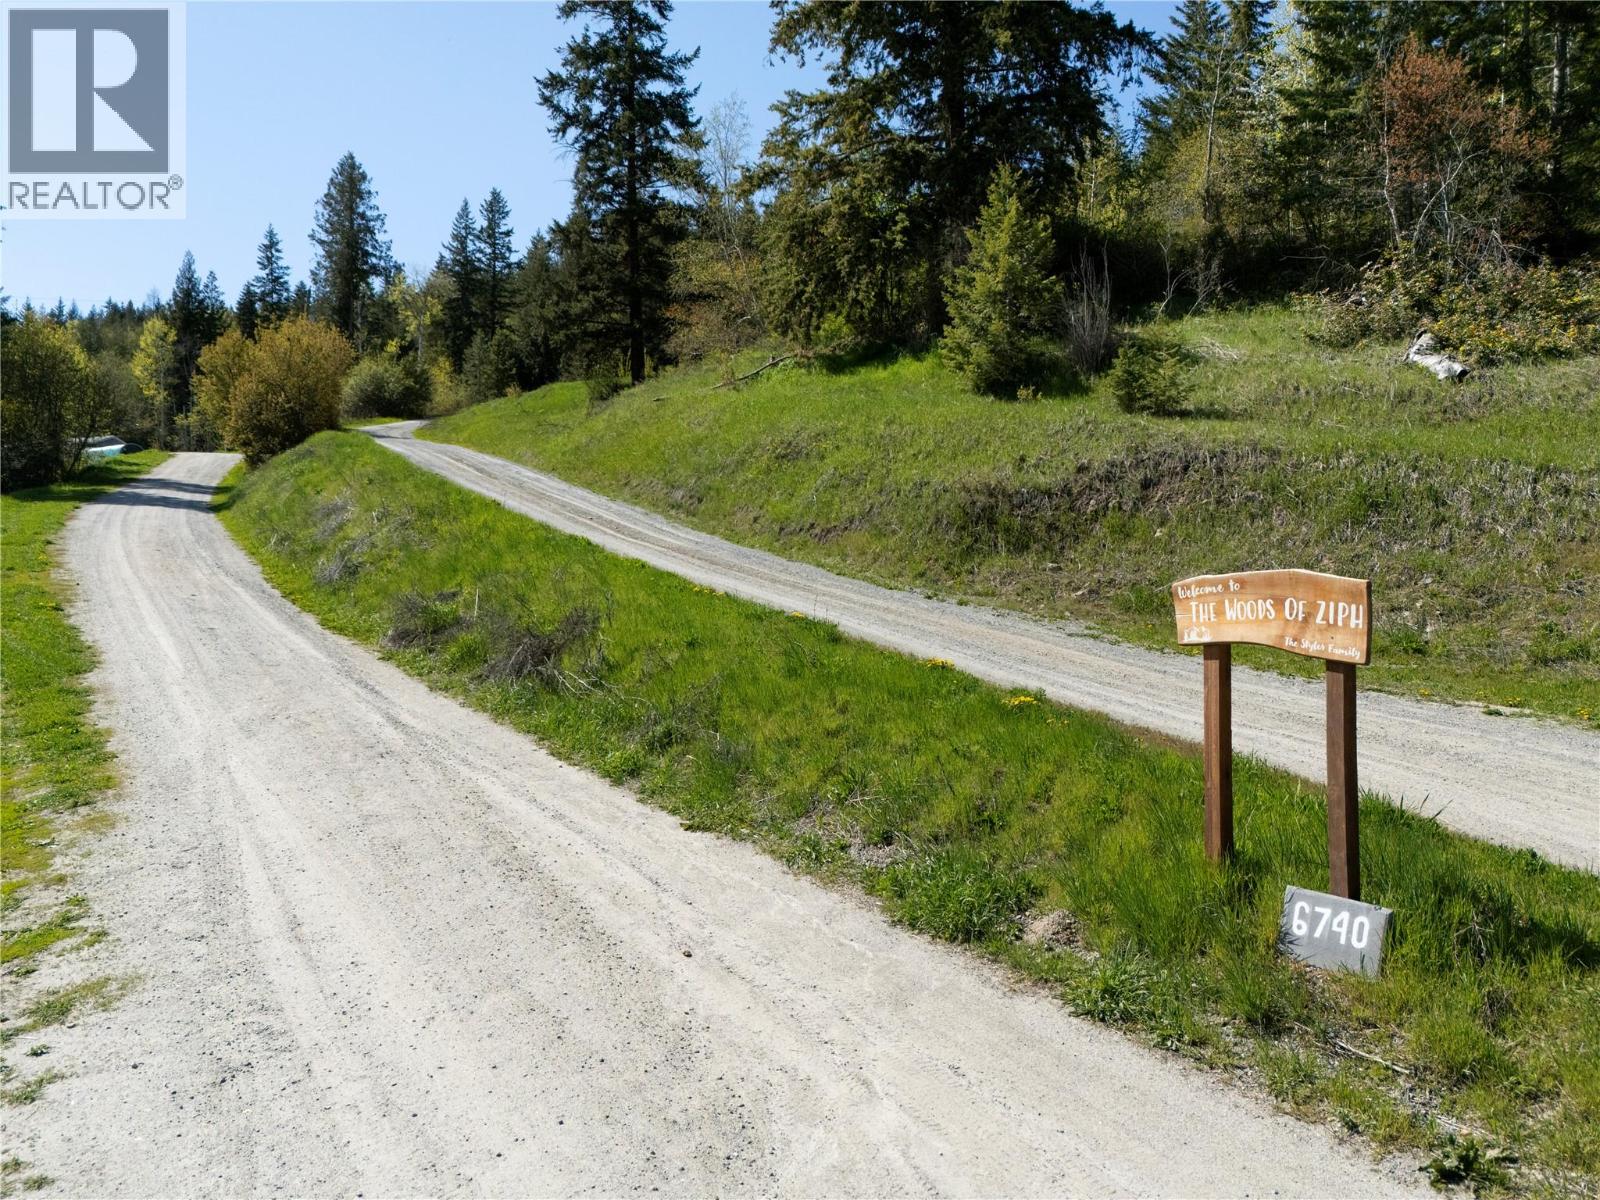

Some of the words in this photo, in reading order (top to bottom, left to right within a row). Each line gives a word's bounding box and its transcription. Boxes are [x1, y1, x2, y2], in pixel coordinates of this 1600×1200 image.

[1177, 583, 1224, 599] Welcome
[1229, 579, 1241, 592] to
[1189, 601, 1217, 623] THE
[1224, 598, 1275, 621] WOODS
[1284, 597, 1307, 622] OF
[1315, 600, 1364, 629] ZIPH
[1284, 636, 1298, 647] The
[1328, 643, 1361, 660] Family
[1292, 901, 1370, 949] 6740
